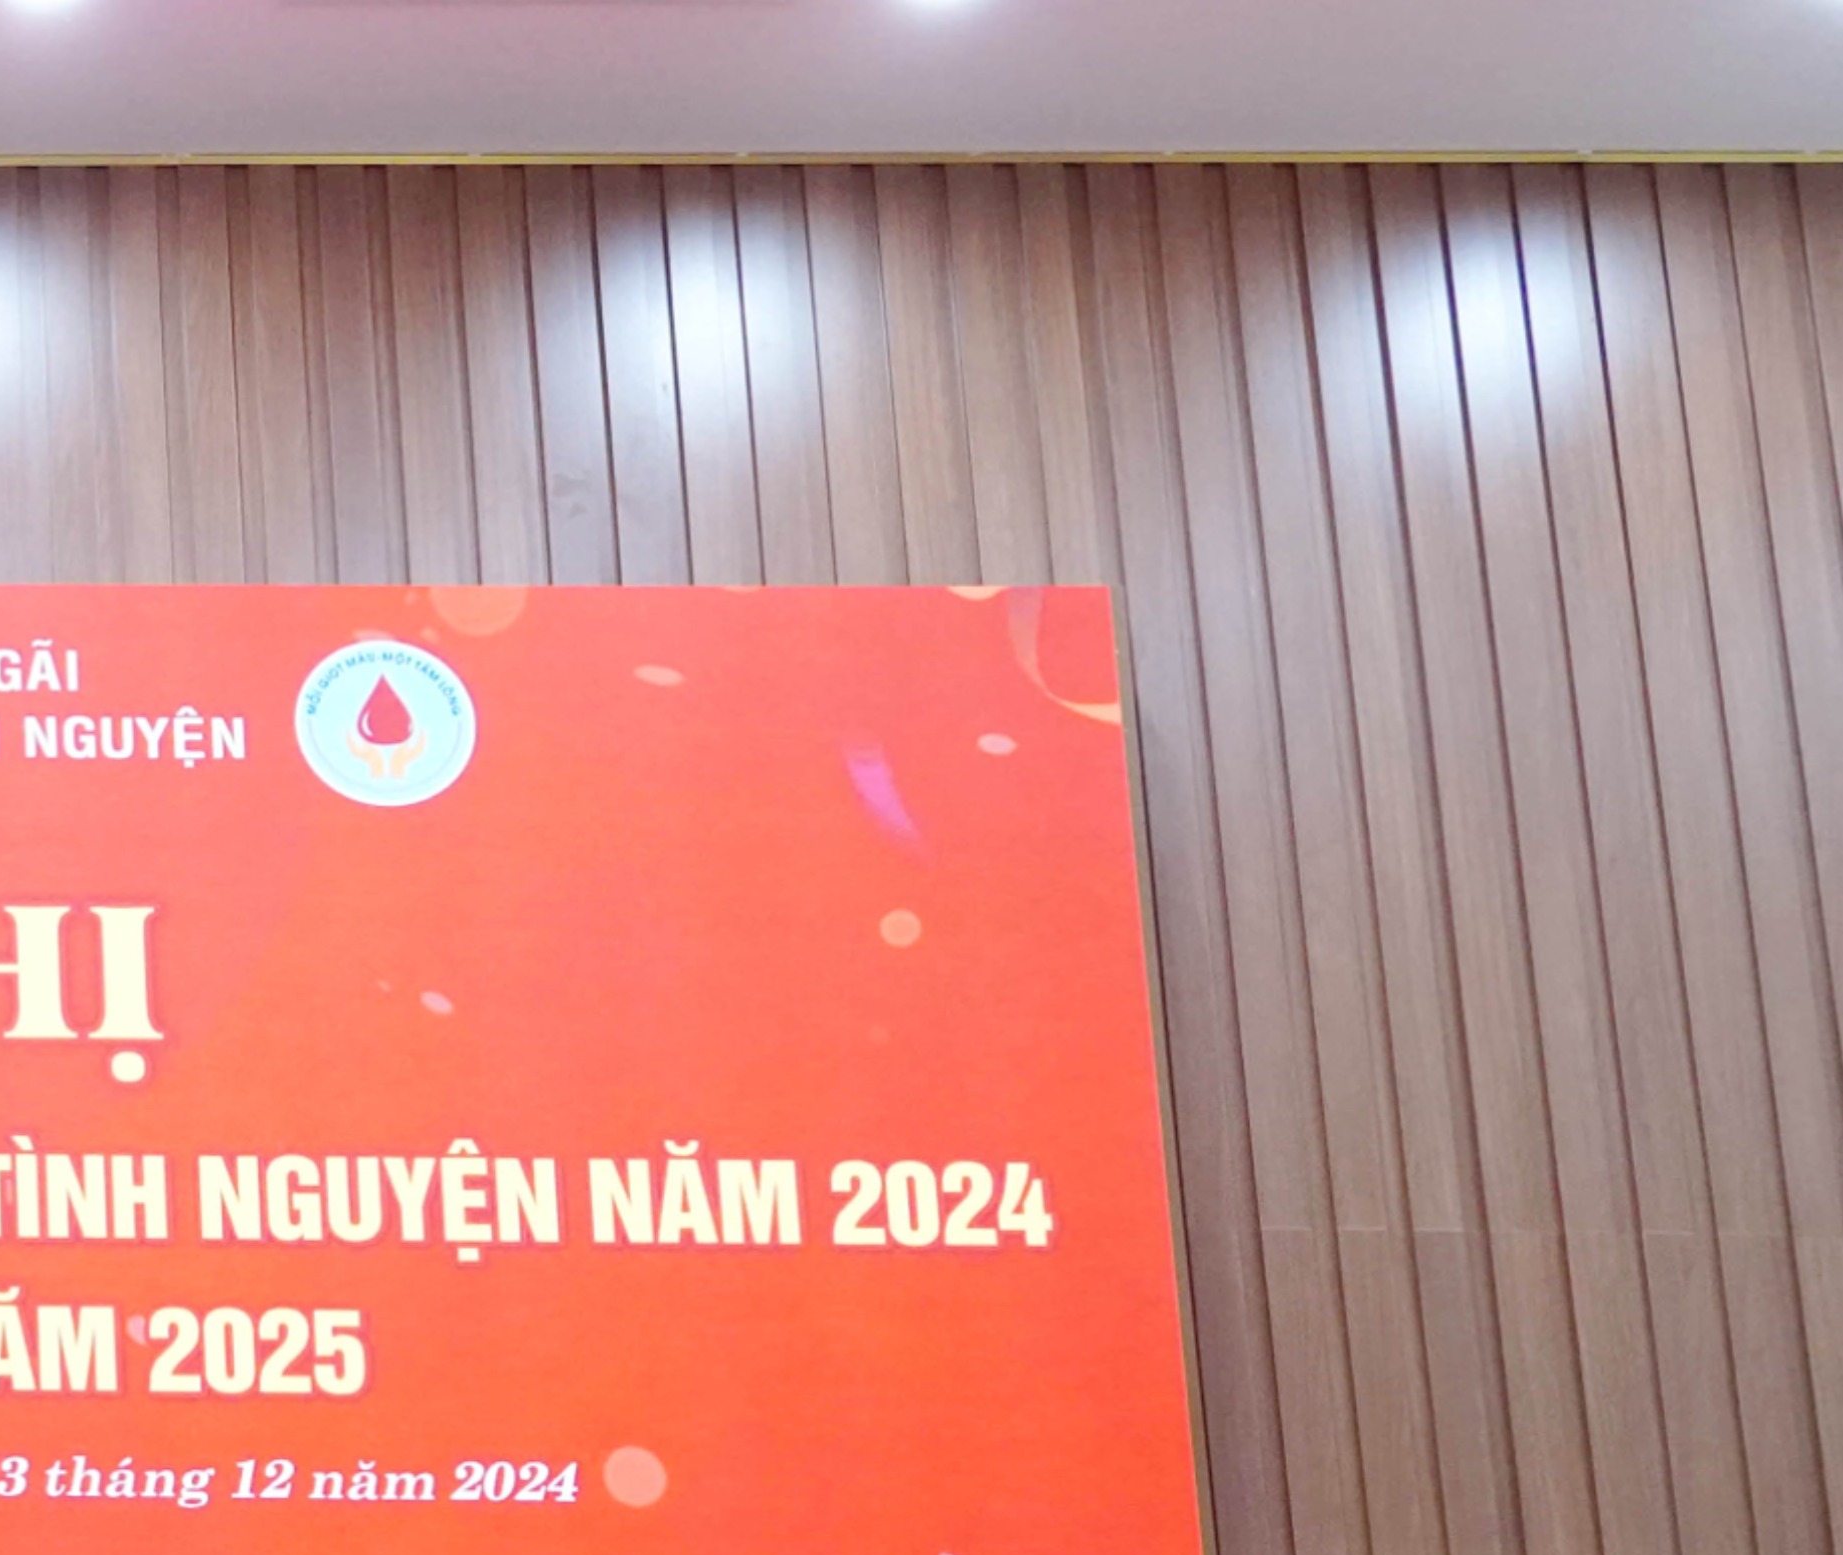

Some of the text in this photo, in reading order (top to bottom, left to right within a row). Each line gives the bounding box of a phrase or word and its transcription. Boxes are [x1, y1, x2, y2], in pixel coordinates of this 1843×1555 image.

[23, 706, 247, 770] NGUYỆN
[200, 1139, 561, 1262] NGUYỆN
[589, 1142, 802, 1245] NĂM
[831, 1161, 1054, 1247] 2024
[149, 1308, 367, 1396] 2025
[46, 1456, 217, 1510] tháng
[231, 1459, 296, 1500] 12
[309, 1461, 435, 1502] năm
[451, 1461, 580, 1503] 2024
